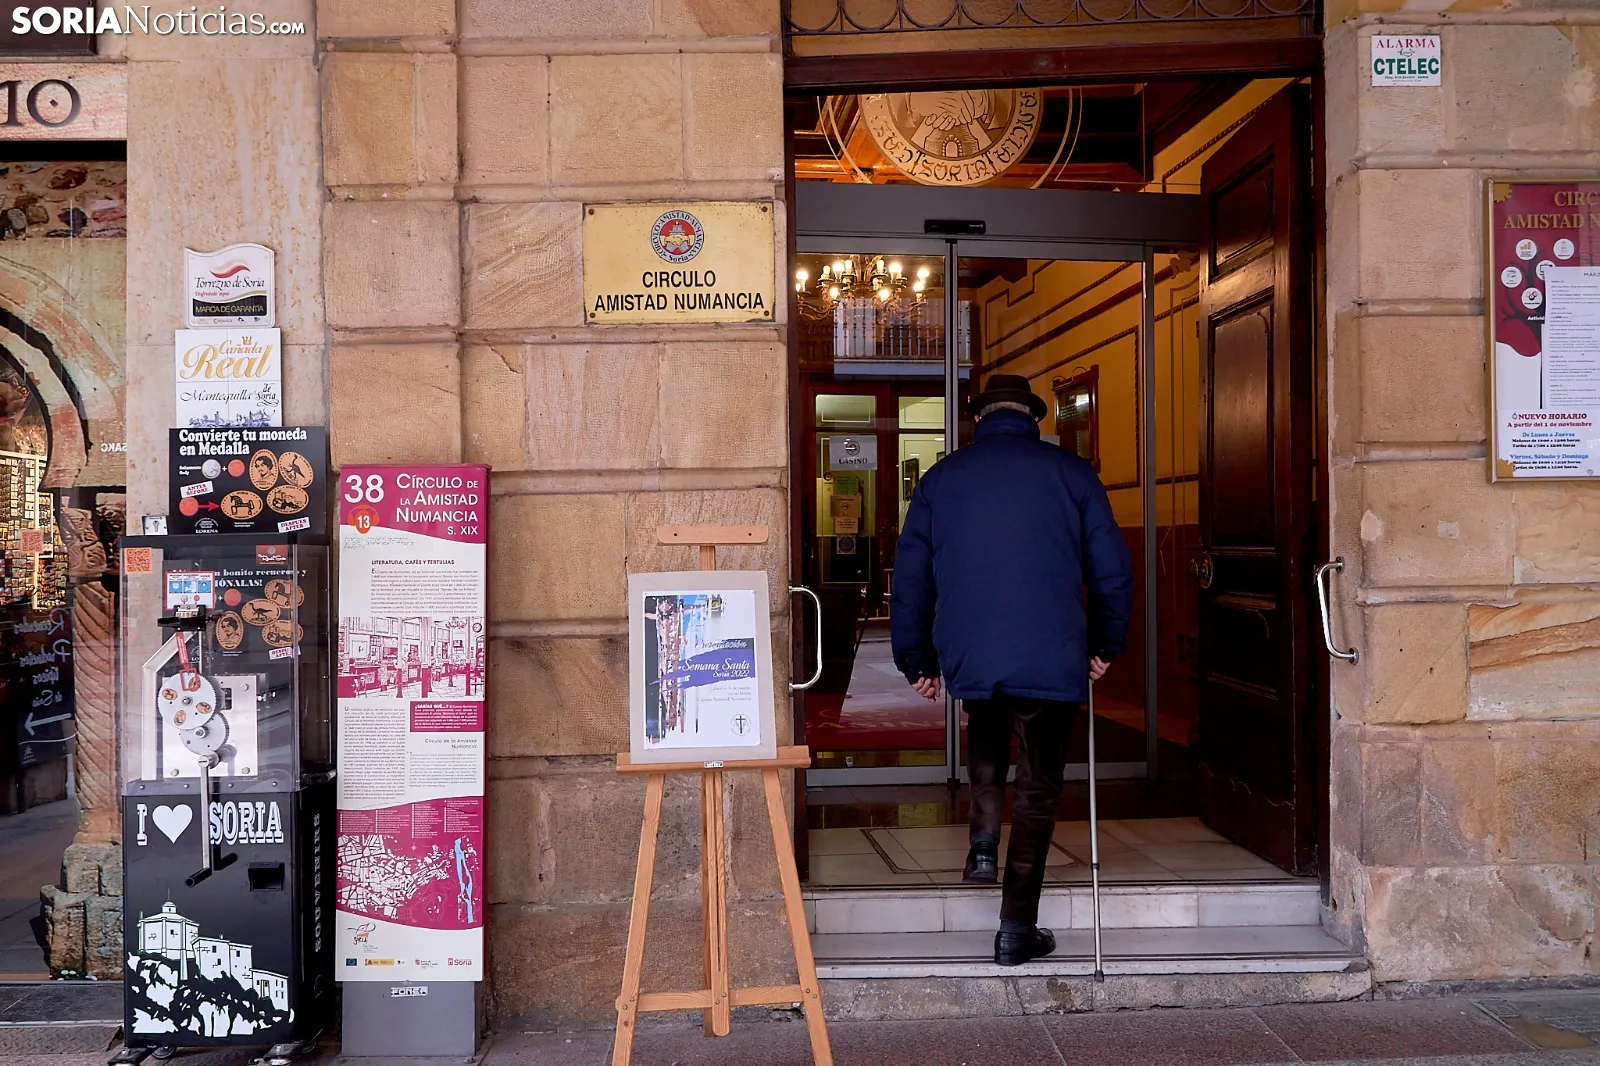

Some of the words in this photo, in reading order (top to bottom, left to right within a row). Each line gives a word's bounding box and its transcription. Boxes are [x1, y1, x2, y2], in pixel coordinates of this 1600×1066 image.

[1376, 38, 1435, 48] ALARMA
[1373, 58, 1439, 75] CTELEC
[0, 79, 82, 128] 10
[919, 156, 992, 182] SORIA
[1554, 191, 1600, 206] CIRC
[1503, 213, 1584, 229] AMISTAD
[668, 254, 689, 262] Soria
[194, 277, 231, 290] Torrezno
[232, 276, 241, 288] de
[242, 276, 265, 288] Soria
[642, 270, 716, 287] CIRCULO
[594, 294, 667, 311] AMISTAD
[674, 292, 764, 310] NUMANCIA
[195, 305, 220, 313] MARCA
[220, 305, 230, 313] DE
[180, 344, 273, 379] Real
[180, 389, 251, 403] Mantequilla
[255, 391, 276, 400] Soria
[179, 429, 240, 443] Convierte
[242, 430, 257, 442] tu
[258, 428, 307, 441] moneda
[179, 445, 198, 456] en
[198, 442, 250, 455] Medalla
[838, 457, 868, 465] CASINO
[187, 483, 207, 491] ANTES
[344, 474, 385, 503] 38
[466, 480, 478, 488] DE
[186, 487, 209, 496] BEFORE
[357, 515, 370, 529] 13
[447, 526, 457, 535] S.
[460, 526, 478, 535] XIX
[223, 568, 253, 576] bonito
[301, 569, 307, 577] y
[694, 638, 748, 649] Presentación
[681, 658, 719, 672] Semana
[721, 657, 750, 671] Santa
[713, 669, 730, 678] Soria
[730, 669, 749, 677] 2022
[136, 803, 148, 846] I
[209, 801, 284, 845] SORIA
[313, 813, 322, 953] SOUVENIRS
[454, 958, 473, 966] Soria
